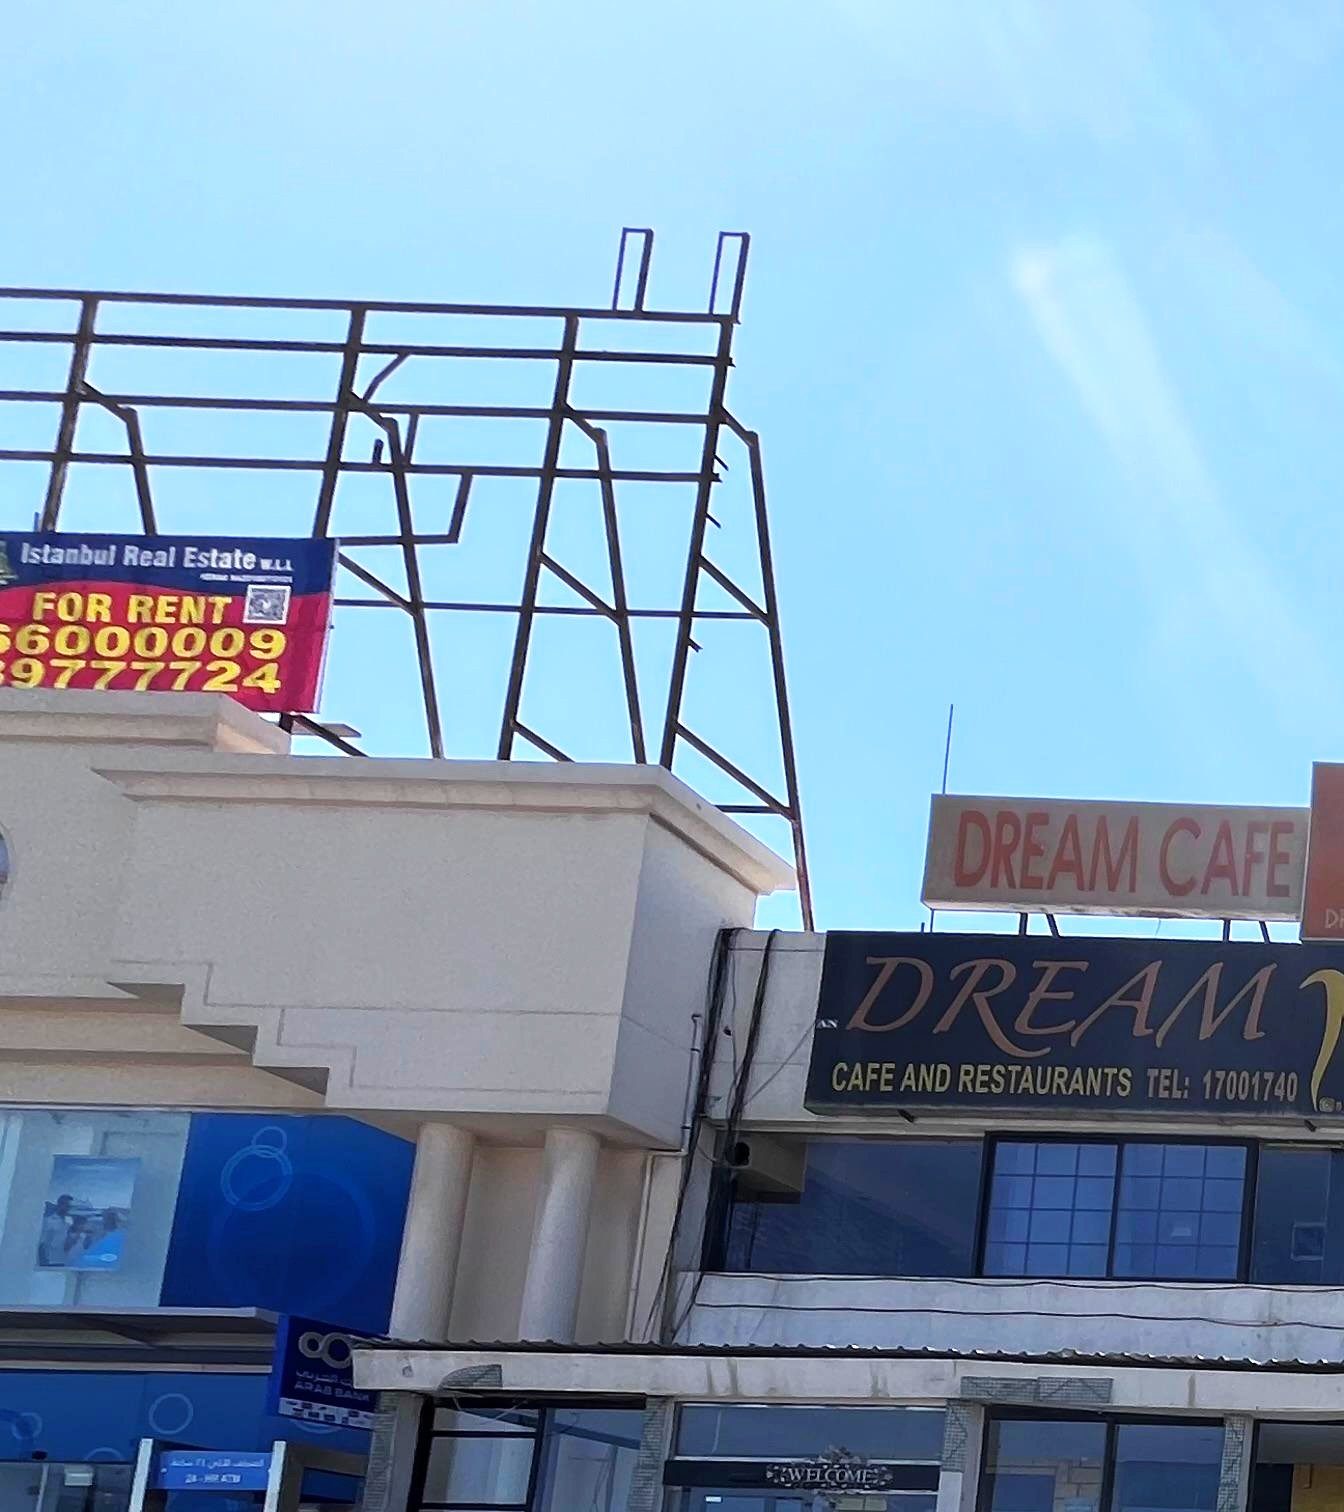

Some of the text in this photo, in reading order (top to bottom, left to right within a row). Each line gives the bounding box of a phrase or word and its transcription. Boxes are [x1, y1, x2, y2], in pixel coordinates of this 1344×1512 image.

[20, 542, 116, 567] Istanbul
[122, 545, 176, 569] Real
[182, 547, 257, 571] Estate
[32, 592, 233, 625] FOR RENT
[0, 657, 282, 694] 9777724
[952, 809, 1292, 899] DREAM CAFE
[845, 956, 1278, 1058] DREAM
[832, 1062, 1298, 1103] CAFE AND RESTAURANTS TEL: 17001740
[785, 1467, 875, 1483] WELCOME
